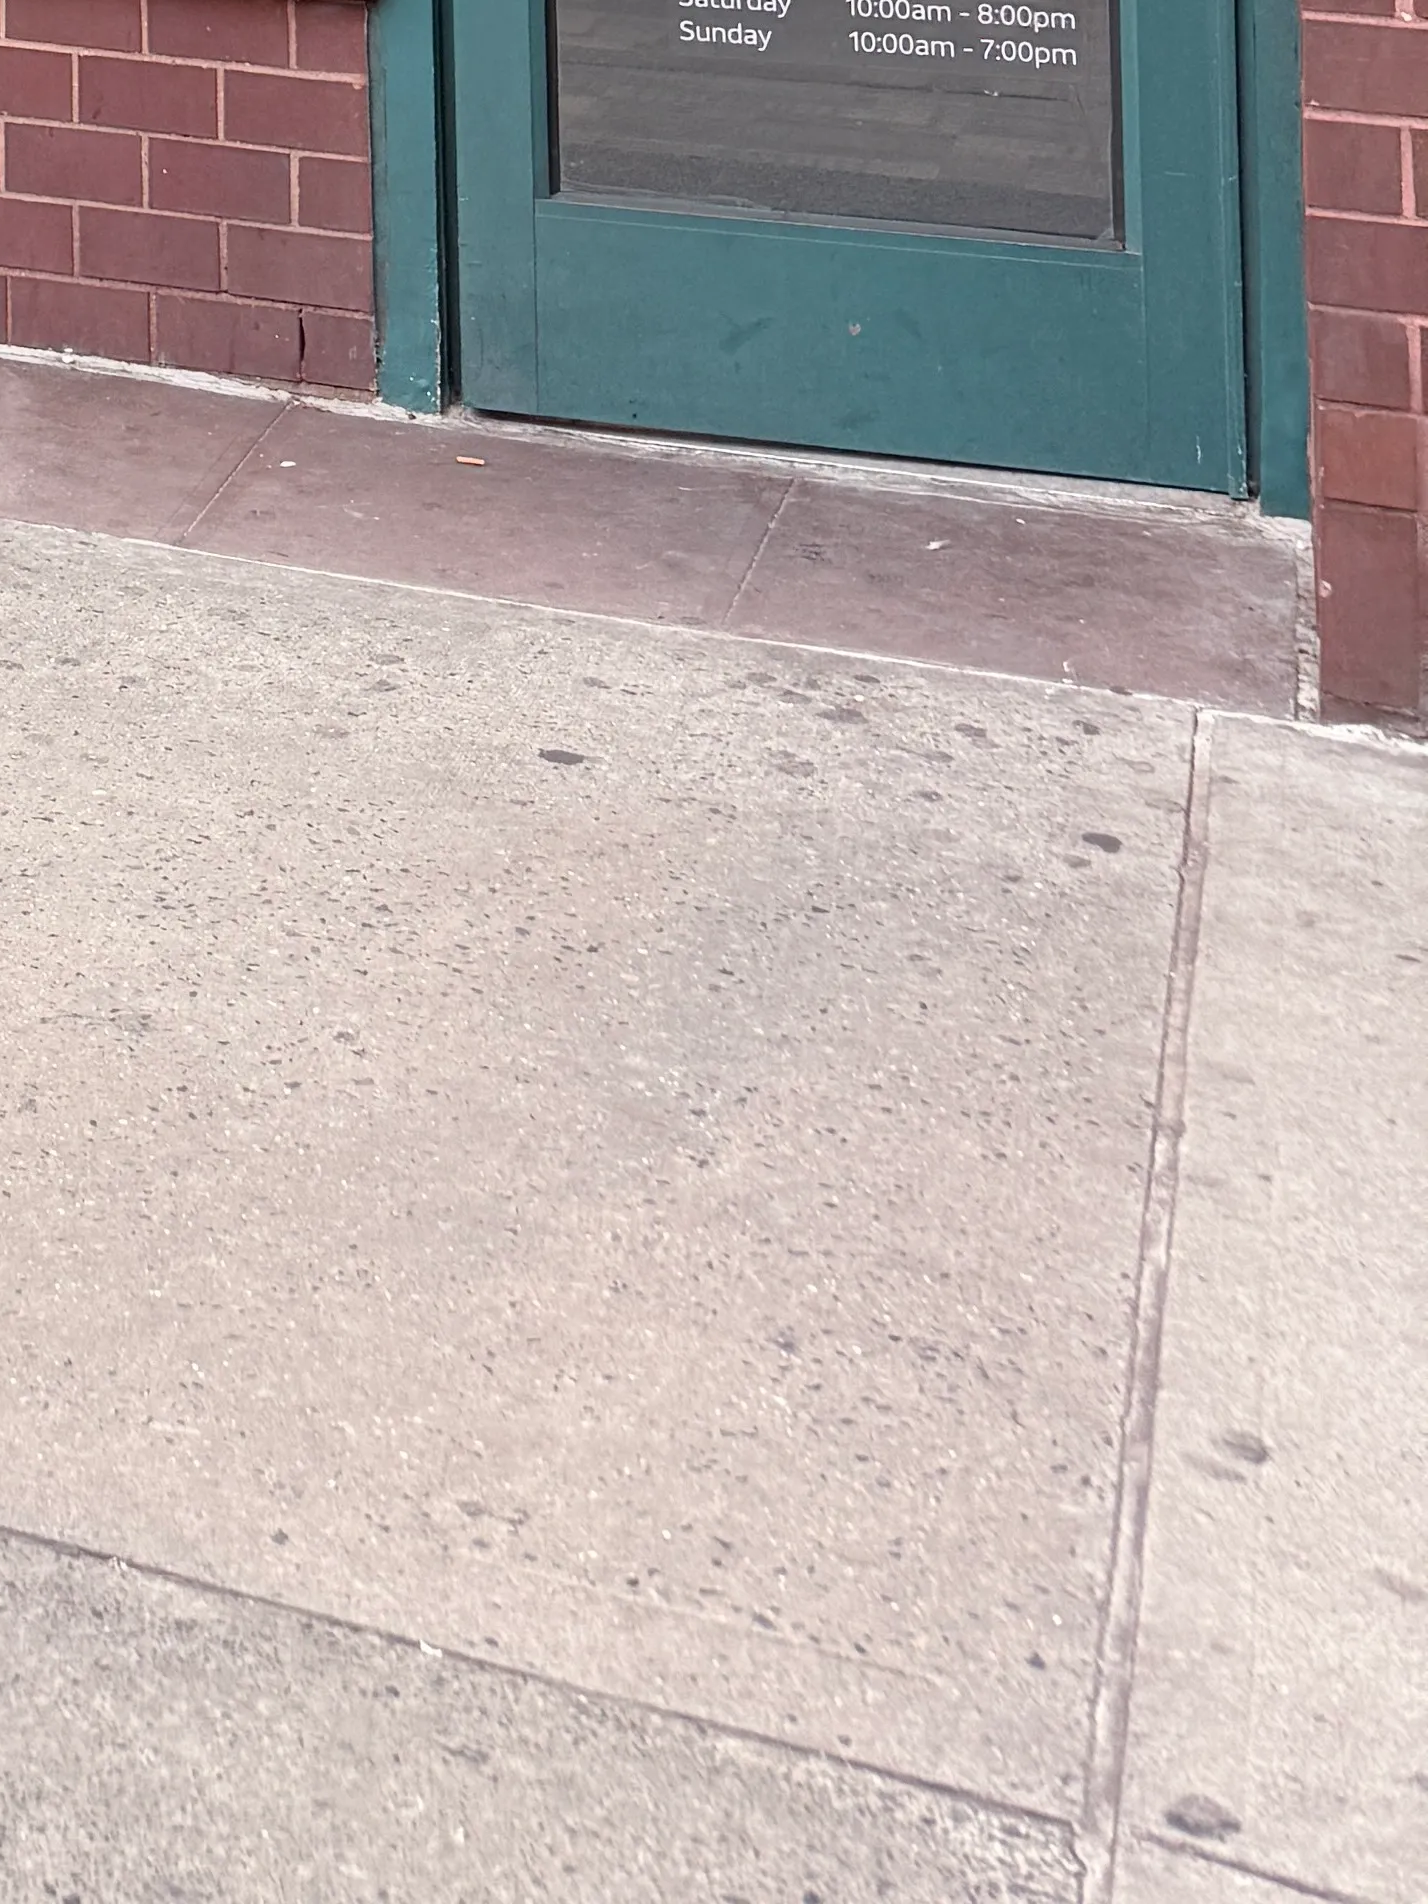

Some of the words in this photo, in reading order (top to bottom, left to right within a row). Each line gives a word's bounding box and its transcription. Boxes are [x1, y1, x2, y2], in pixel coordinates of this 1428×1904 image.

[977, 2, 1076, 33] 8:00pm
[678, 20, 773, 51] Sunday
[848, 30, 955, 59] 10:00am
[979, 39, 1078, 70] 7:00pm
